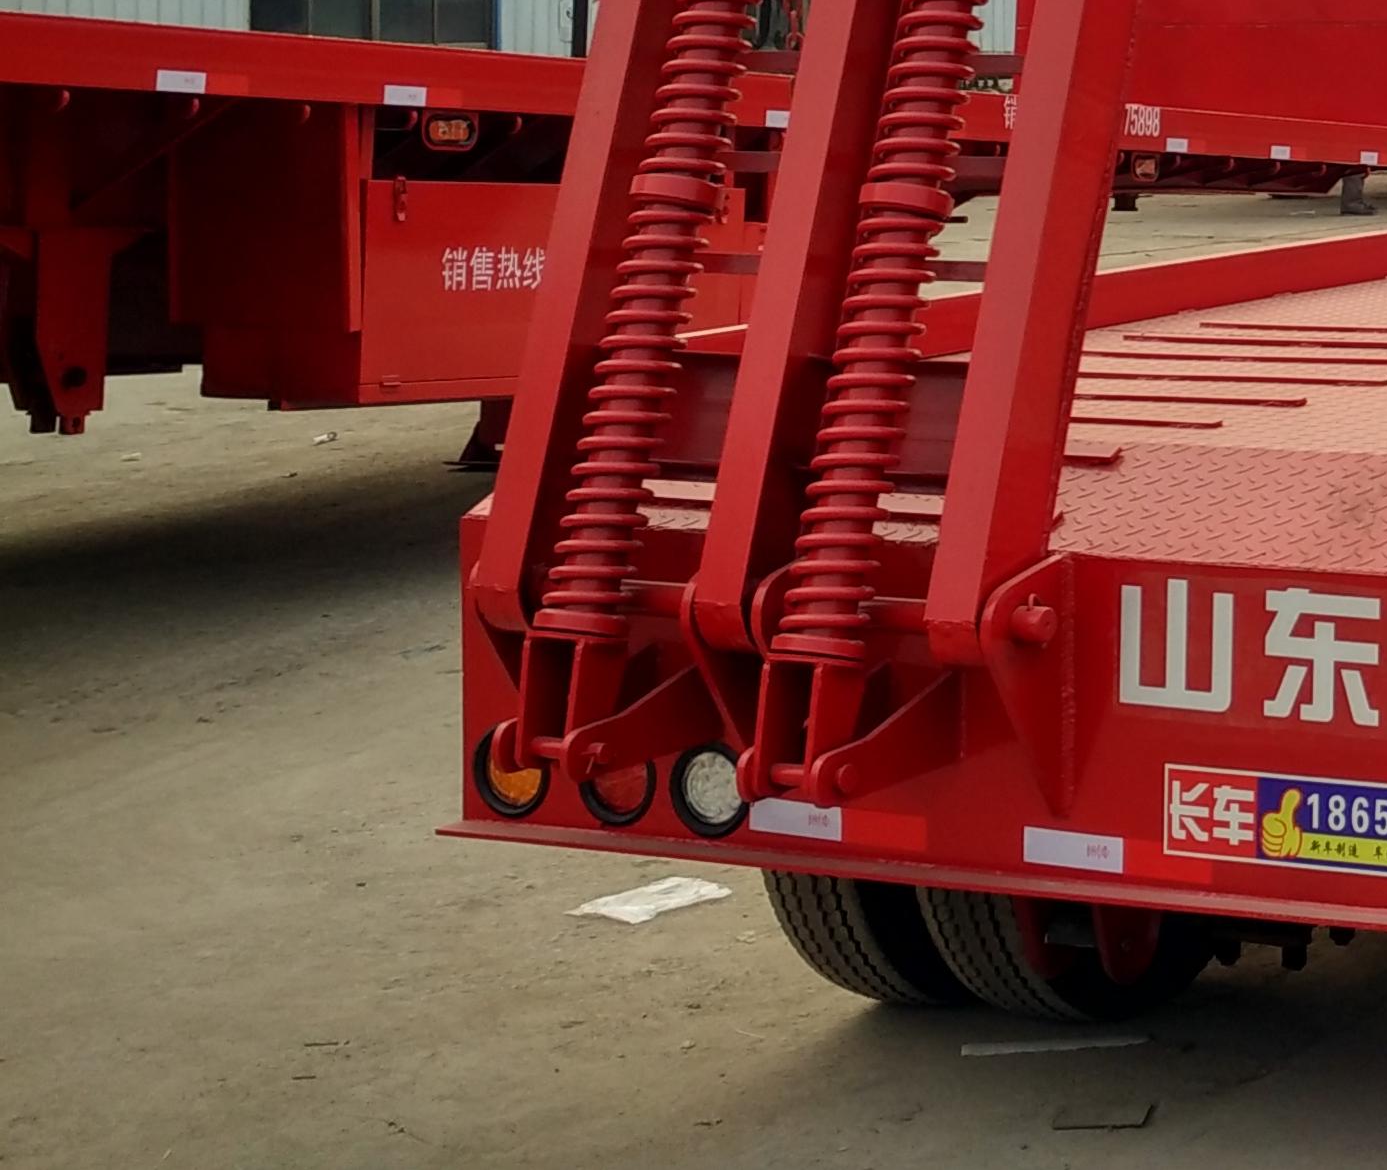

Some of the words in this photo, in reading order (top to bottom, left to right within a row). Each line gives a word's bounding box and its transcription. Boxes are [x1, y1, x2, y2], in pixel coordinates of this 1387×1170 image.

[1123, 103, 1161, 138] 75898
[442, 246, 546, 291] 销售热线
[1169, 780, 1256, 846] 长车
